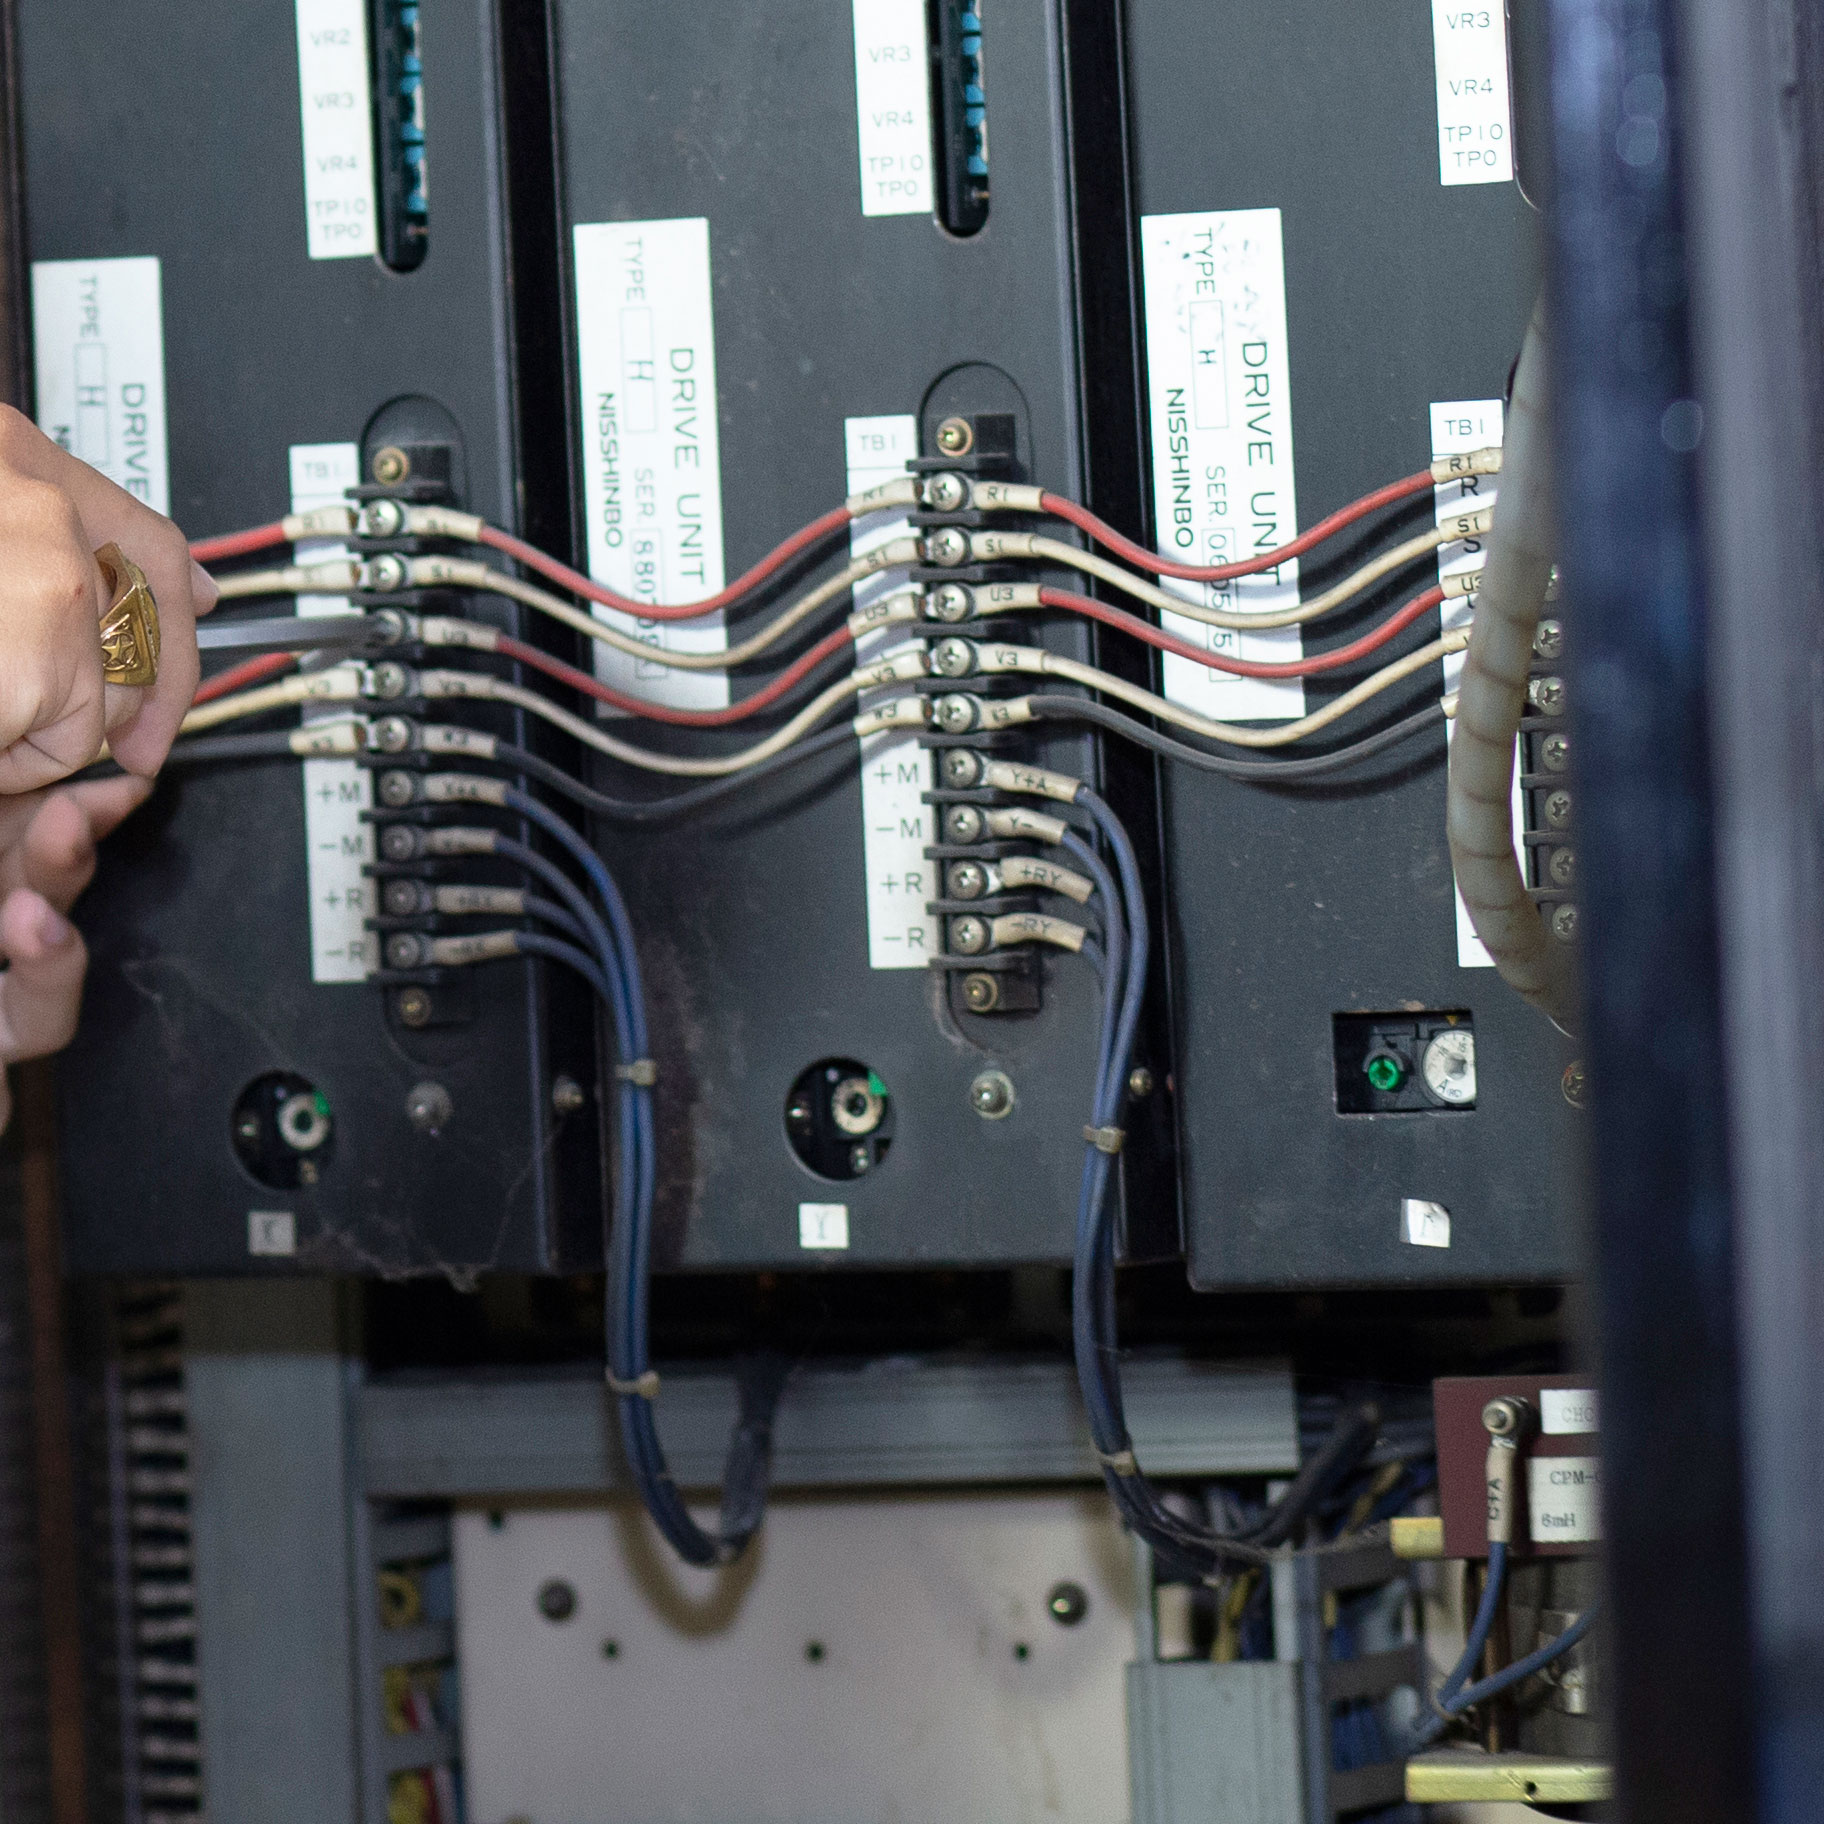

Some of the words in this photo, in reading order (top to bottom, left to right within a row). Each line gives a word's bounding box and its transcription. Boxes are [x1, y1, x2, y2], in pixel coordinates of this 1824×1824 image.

[1446, 11, 1490, 29] VR3
[868, 46, 911, 63] VR3
[1449, 78, 1493, 96] VR4
[872, 111, 914, 128] VR4
[624, 237, 646, 301] TYPE
[1193, 227, 1216, 295] TYPE
[79, 274, 100, 338] TYPE
[1197, 348, 1218, 366] H
[627, 360, 654, 380] H
[77, 385, 105, 407] H
[1241, 341, 1275, 467] DRIVE
[670, 348, 700, 469] DRIVE
[1444, 418, 1484, 436] TB1
[122, 382, 151, 502] DRIVE
[860, 434, 897, 452] TB1
[597, 392, 623, 548] NISSHINBO
[1166, 387, 1194, 548] NISSHINBO
[1449, 456, 1473, 473] R1
[1461, 475, 1479, 498] R
[1457, 516, 1480, 533] S1
[676, 492, 705, 585] UNIT
[990, 587, 1014, 603] U3
